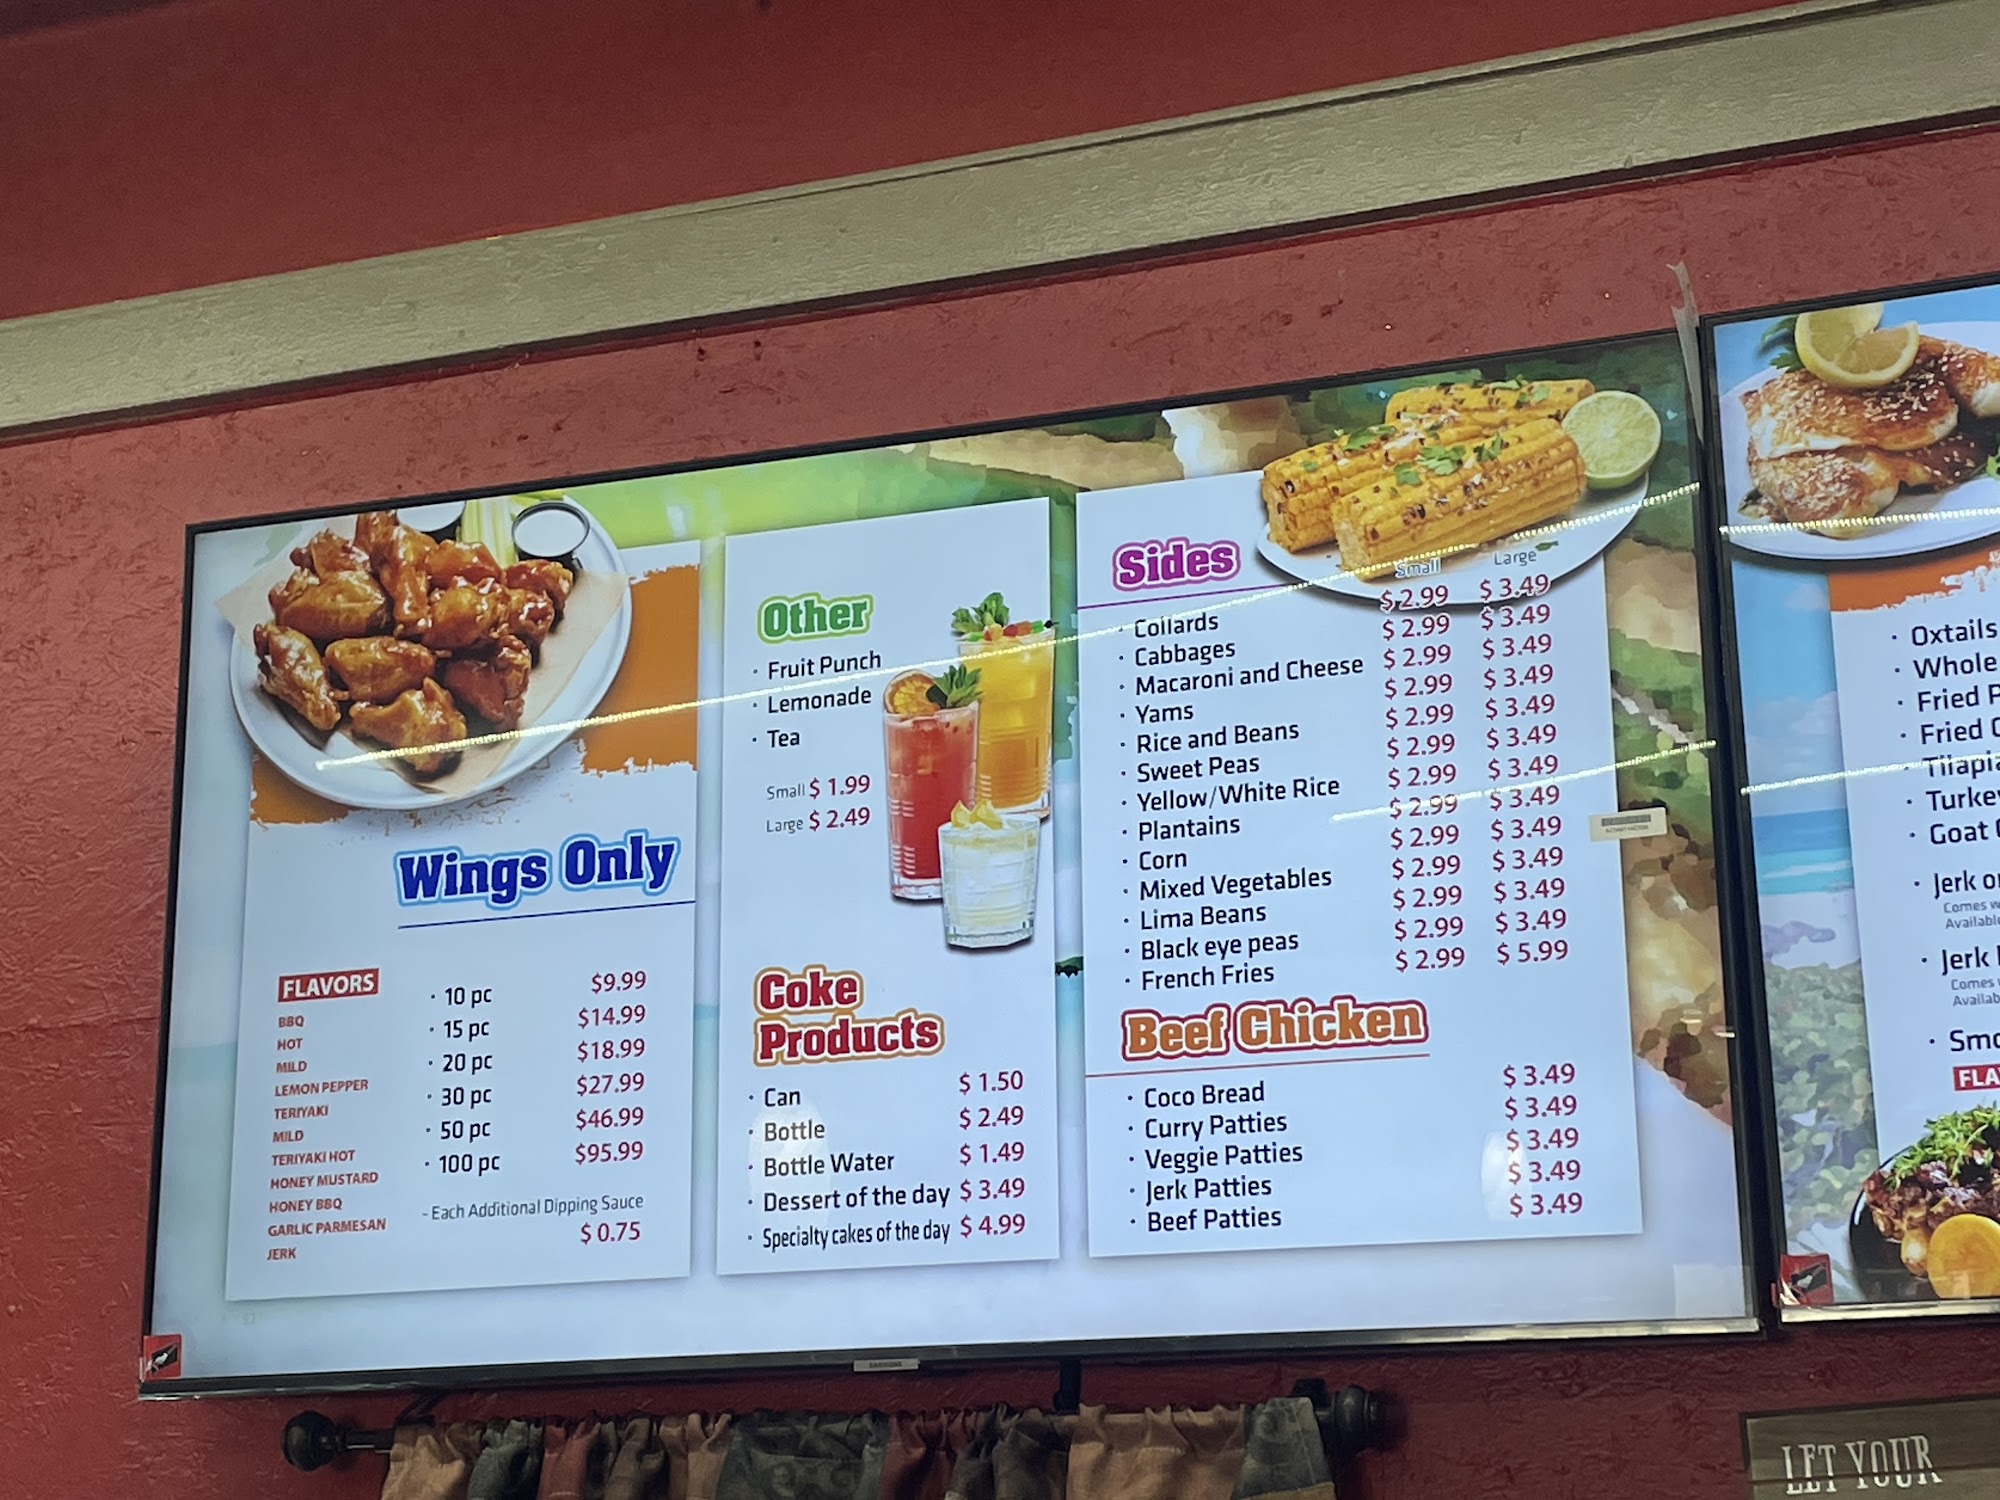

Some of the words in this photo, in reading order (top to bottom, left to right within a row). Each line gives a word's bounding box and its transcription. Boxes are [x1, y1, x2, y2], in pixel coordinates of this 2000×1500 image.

[1119, 543, 1234, 584] Sides
[1396, 559, 1441, 577] Small
[1494, 548, 1538, 568] Large
[764, 599, 867, 638] Other
[1134, 611, 1219, 639] Collards
[1911, 618, 1998, 647] Oxtails
[768, 657, 815, 680] Fruit
[820, 650, 881, 675] Punch
[1135, 642, 1236, 672] Cabbages
[1912, 652, 1998, 679] Whole
[1135, 666, 1234, 696] Macaroni
[1239, 661, 1280, 686] and
[1286, 658, 1364, 681] Cheese
[768, 687, 872, 714] Lemonade
[1917, 684, 1980, 713] Fried
[1134, 704, 1194, 725] Yams
[766, 729, 800, 748] Tea
[1137, 732, 1182, 754] Rice
[1187, 725, 1227, 750] and
[1234, 724, 1300, 745] Beans
[1920, 717, 1983, 745] Fried
[1137, 759, 1203, 783] Sweet
[1208, 756, 1260, 776] Peas
[766, 783, 806, 801] Small
[1136, 780, 1287, 812] Yellow/White
[1292, 776, 1340, 799] Rice
[766, 819, 804, 835] Large
[1139, 815, 1241, 842] Plantains
[1930, 821, 1989, 845] Goat
[399, 853, 547, 904] Wings
[564, 836, 675, 887] Only
[1139, 850, 1187, 871] Corn
[1140, 875, 1205, 901] Mixed
[1210, 866, 1332, 899] Vegetables
[1934, 869, 1977, 900] Jerk
[1140, 908, 1194, 930] Lima
[1200, 905, 1267, 926] Beans
[1943, 901, 1988, 914] Comes
[1141, 936, 1199, 961] Black
[1204, 938, 1242, 961] eye
[1247, 934, 1299, 959] peas
[1941, 945, 1990, 977] Jerk
[283, 975, 375, 998] FLAVORS
[591, 970, 647, 995] $9.99
[1142, 965, 1215, 991] French
[1222, 962, 1275, 985] Fries
[1950, 978, 1995, 991] Comes
[445, 986, 466, 1006] 10
[471, 988, 492, 1009] pc
[760, 972, 857, 1010] Coke
[278, 1015, 305, 1028] BBQ
[577, 1004, 646, 1030] $14.99
[1128, 1009, 1225, 1054] Beef
[1240, 1002, 1421, 1047] Chicken
[276, 1037, 303, 1051] HOT
[443, 1019, 463, 1039] 15
[468, 1021, 490, 1043] pc
[760, 1015, 938, 1060] Products
[577, 1038, 645, 1063] $18.99
[275, 1060, 308, 1074] MILD
[442, 1053, 466, 1073] 20
[471, 1055, 493, 1076] pc
[274, 1082, 320, 1097] LEMON
[321, 1078, 369, 1093] PEPPER
[576, 1072, 645, 1097] $27.99
[1959, 1070, 2000, 1088] FLA
[441, 1086, 465, 1107] 30
[470, 1088, 492, 1110] pc
[764, 1087, 801, 1108] Can
[1144, 1087, 1195, 1109] Coco
[1202, 1080, 1265, 1105] Bread
[274, 1105, 329, 1120] TERIYAKI
[575, 1106, 644, 1132] $46.99
[272, 1129, 305, 1143] MILD
[440, 1120, 464, 1140] 50
[469, 1122, 491, 1144] pc
[764, 1118, 826, 1142] Bottle
[1145, 1118, 1204, 1143] Curry
[1209, 1111, 1288, 1136] Patties
[271, 1151, 327, 1167] TERIYAKI
[328, 1149, 356, 1163] HOT
[439, 1153, 473, 1174] 100
[478, 1155, 500, 1177] pc
[575, 1140, 644, 1166] $95.99
[764, 1154, 825, 1178] Bottle
[829, 1152, 895, 1173] Water
[1144, 1145, 1218, 1175] Veggie
[1225, 1141, 1303, 1166] Patties
[270, 1175, 315, 1190] HONEY
[316, 1171, 379, 1187] MUSTARD
[1145, 1178, 1188, 1207] Jerk
[1194, 1174, 1272, 1199] Patties
[269, 1198, 314, 1214] HONEY
[315, 1197, 343, 1211] BBQ
[431, 1203, 465, 1221] Each
[467, 1198, 541, 1218] Additional
[544, 1196, 598, 1217] Dipping
[601, 1194, 644, 1211] Sauce
[764, 1189, 841, 1212] Dessert
[845, 1185, 868, 1208] of
[871, 1185, 907, 1207] the
[912, 1182, 951, 1209] day
[267, 1222, 314, 1237] GARLIC
[315, 1217, 387, 1235] PARMESAN
[1147, 1208, 1198, 1232] Beef
[1203, 1205, 1282, 1230] Patties
[762, 1225, 829, 1254] Specialty
[832, 1222, 873, 1245] cakes
[876, 1220, 892, 1243] of
[894, 1220, 920, 1242] the
[923, 1218, 951, 1245] day
[266, 1247, 297, 1261] JERK
[1781, 1444, 1837, 1494] LET
[1845, 1435, 1942, 1489] YOUR
